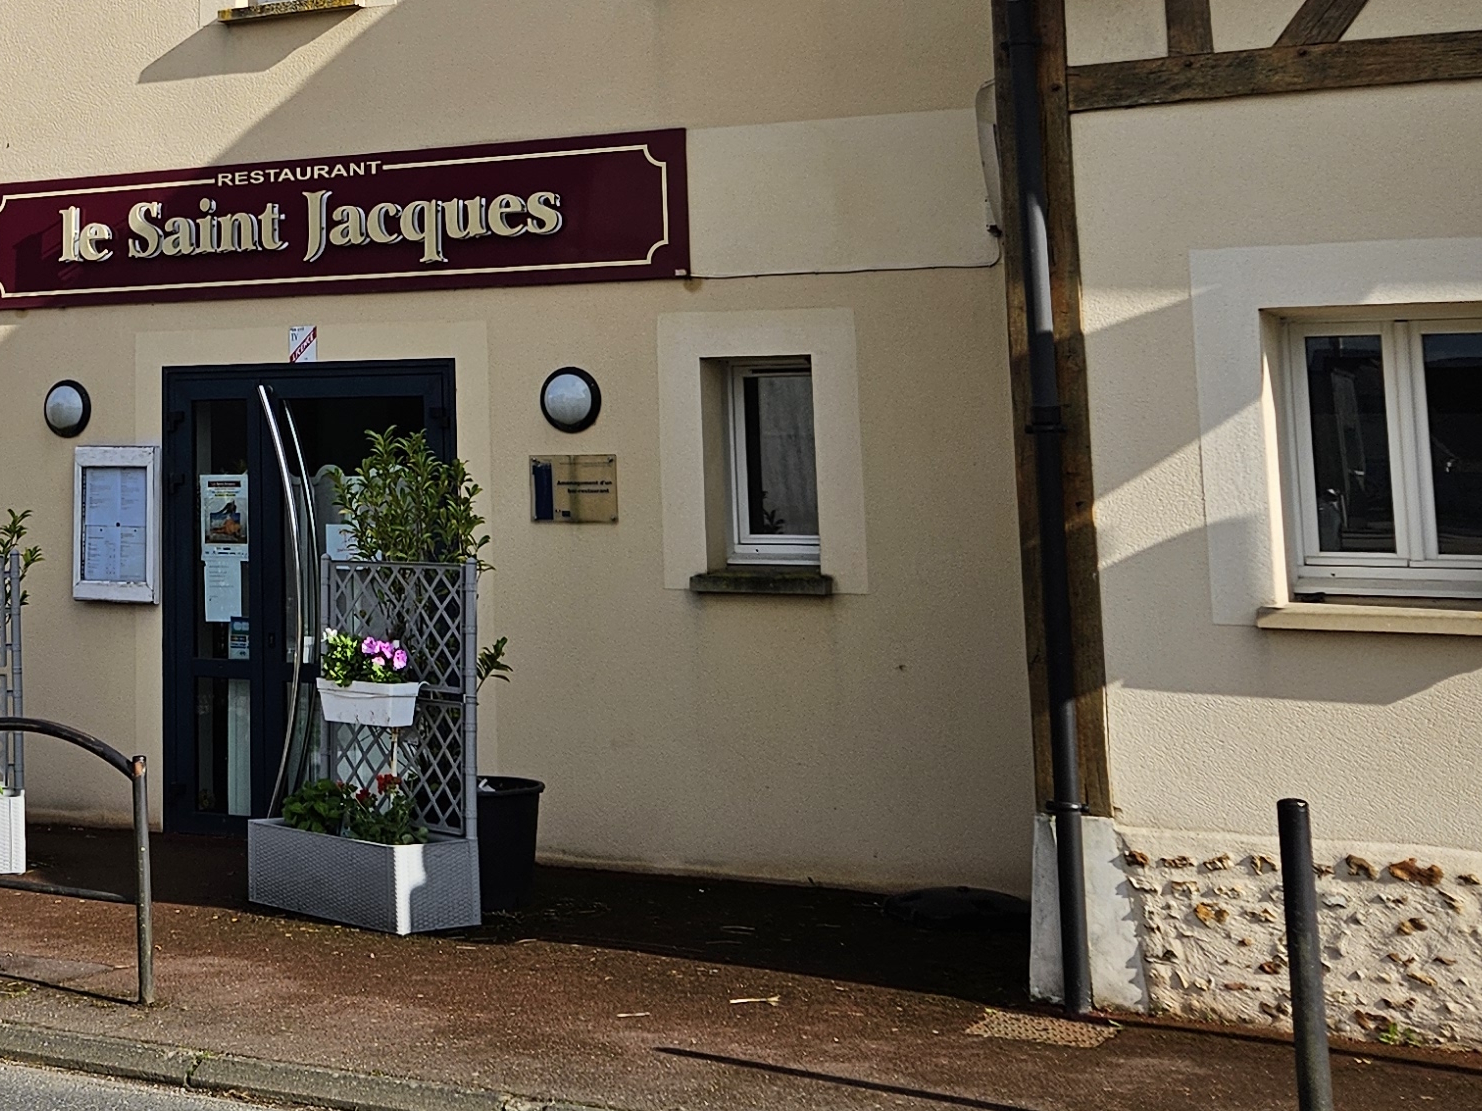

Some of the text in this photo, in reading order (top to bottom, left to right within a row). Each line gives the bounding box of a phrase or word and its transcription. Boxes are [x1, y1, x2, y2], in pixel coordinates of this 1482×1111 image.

[217, 160, 382, 187] RESTAURANT
[58, 189, 563, 264] le Saint Jacques
[292, 331, 314, 362] LICENCE
